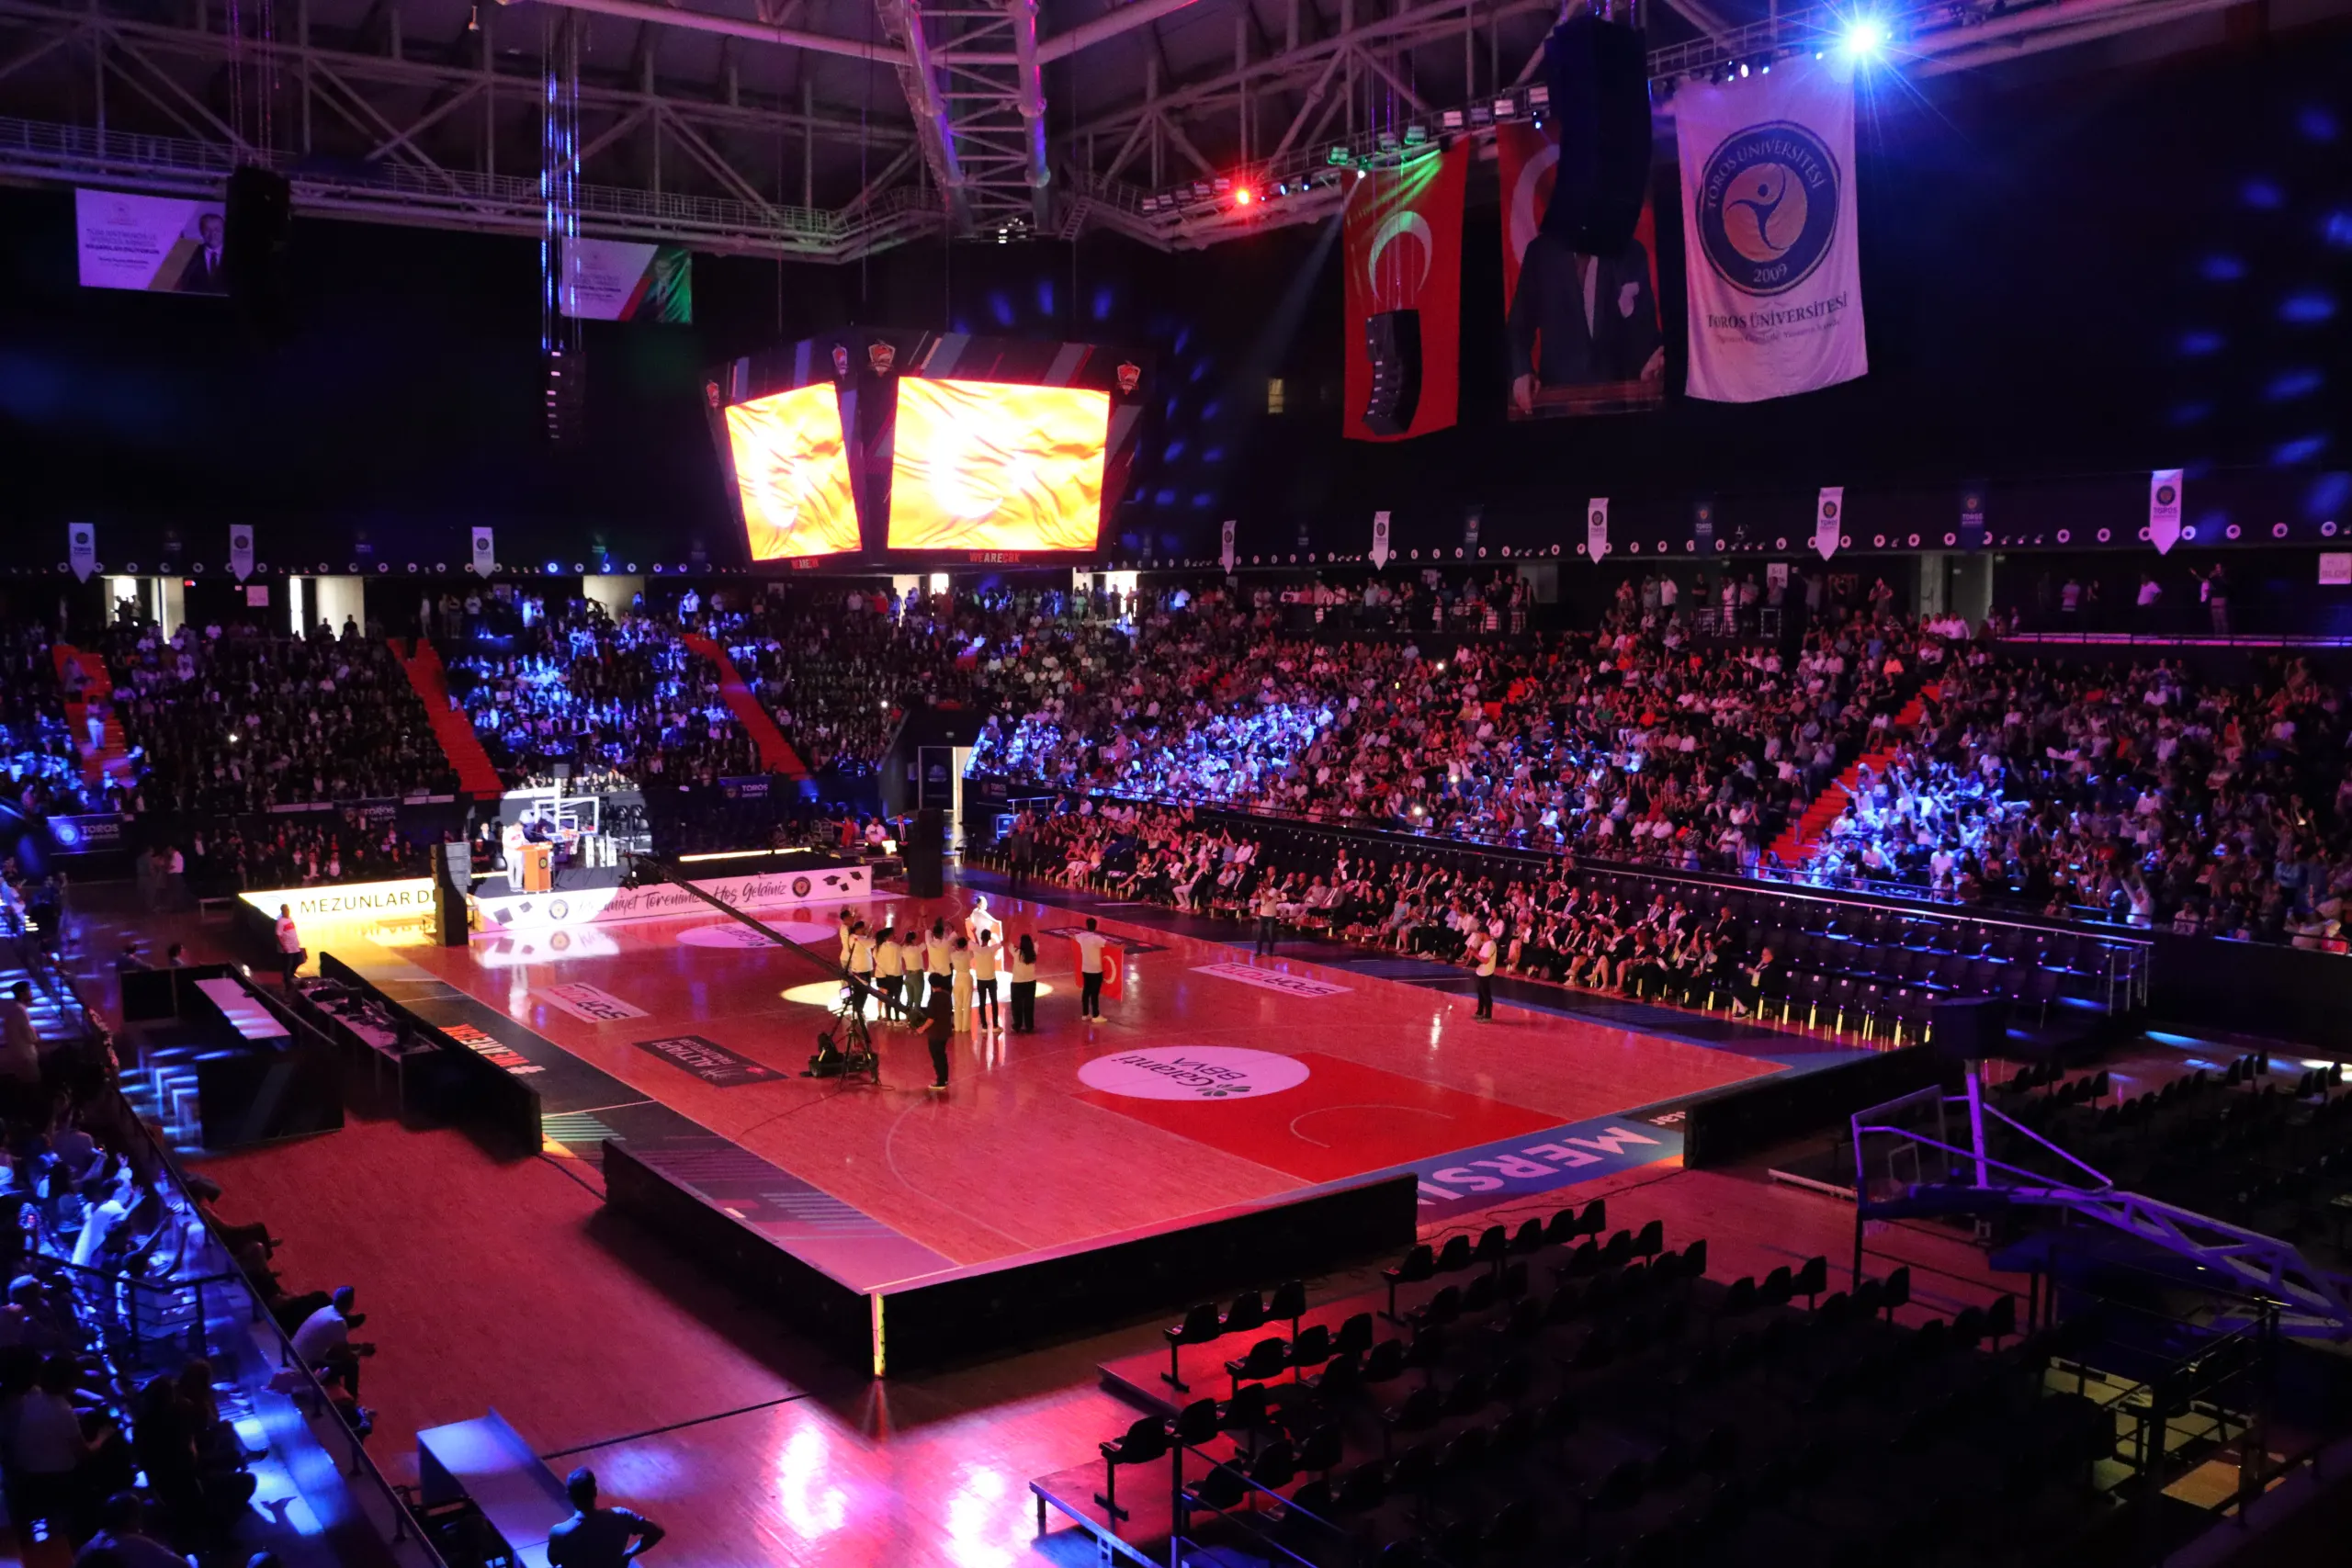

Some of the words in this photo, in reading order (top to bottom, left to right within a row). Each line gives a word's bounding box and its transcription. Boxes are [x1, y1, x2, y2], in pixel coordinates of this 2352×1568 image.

[1709, 156, 1737, 208] TOROS
[1753, 262, 1788, 283] 2009
[1706, 313, 1747, 329] TOROS
[741, 784, 769, 792] TOROS
[81, 824, 119, 835] TOROS
[300, 890, 411, 914] MEZUNLAR
[417, 889, 435, 904] D
[742, 880, 788, 903] Geldiniz
[1111, 1055, 1216, 1087] Garanti
[1172, 1057, 1248, 1081] BBVA
